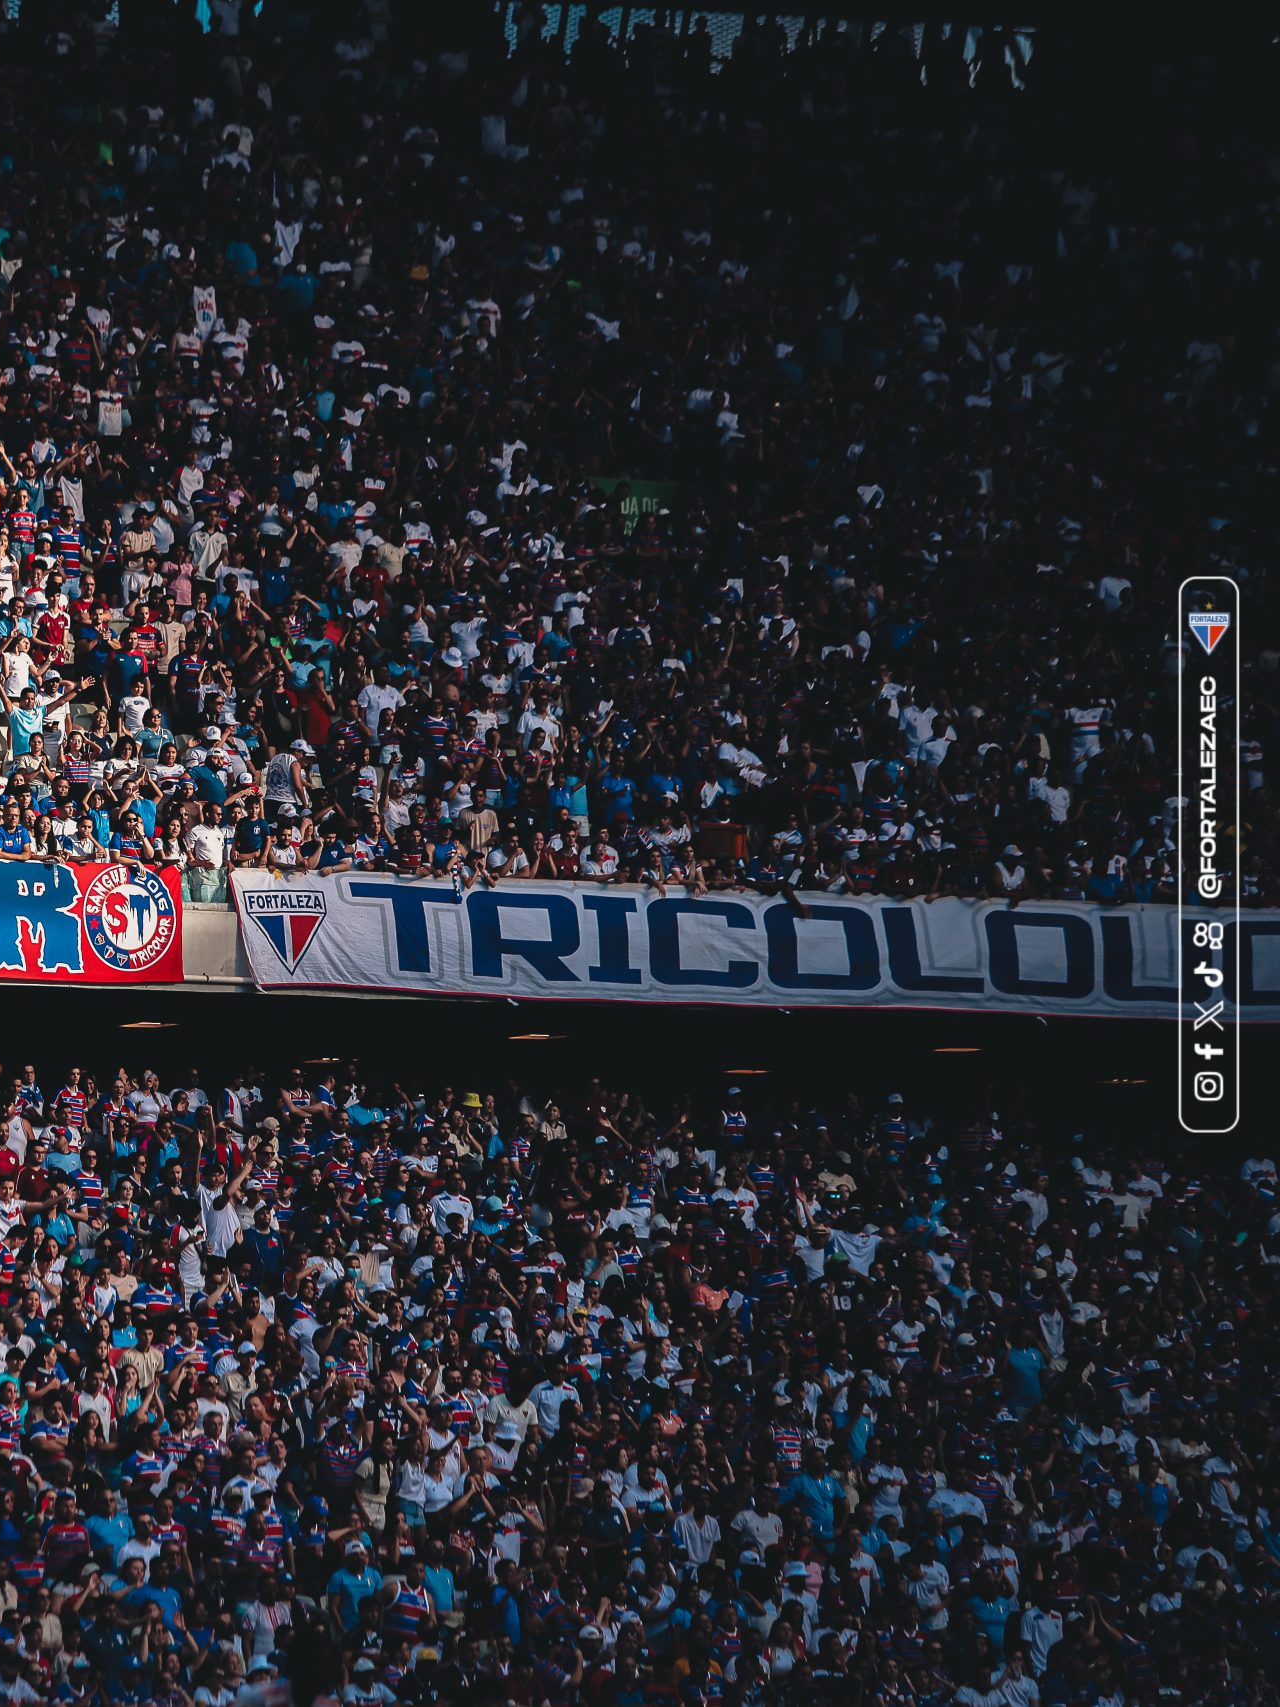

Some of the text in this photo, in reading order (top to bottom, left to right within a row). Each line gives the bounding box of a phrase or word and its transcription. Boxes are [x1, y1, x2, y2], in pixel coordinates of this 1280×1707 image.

[86, 867, 128, 915] SANGUE
[247, 894, 323, 910] FORTALEZA
[129, 917, 173, 968] TRICOLOR
